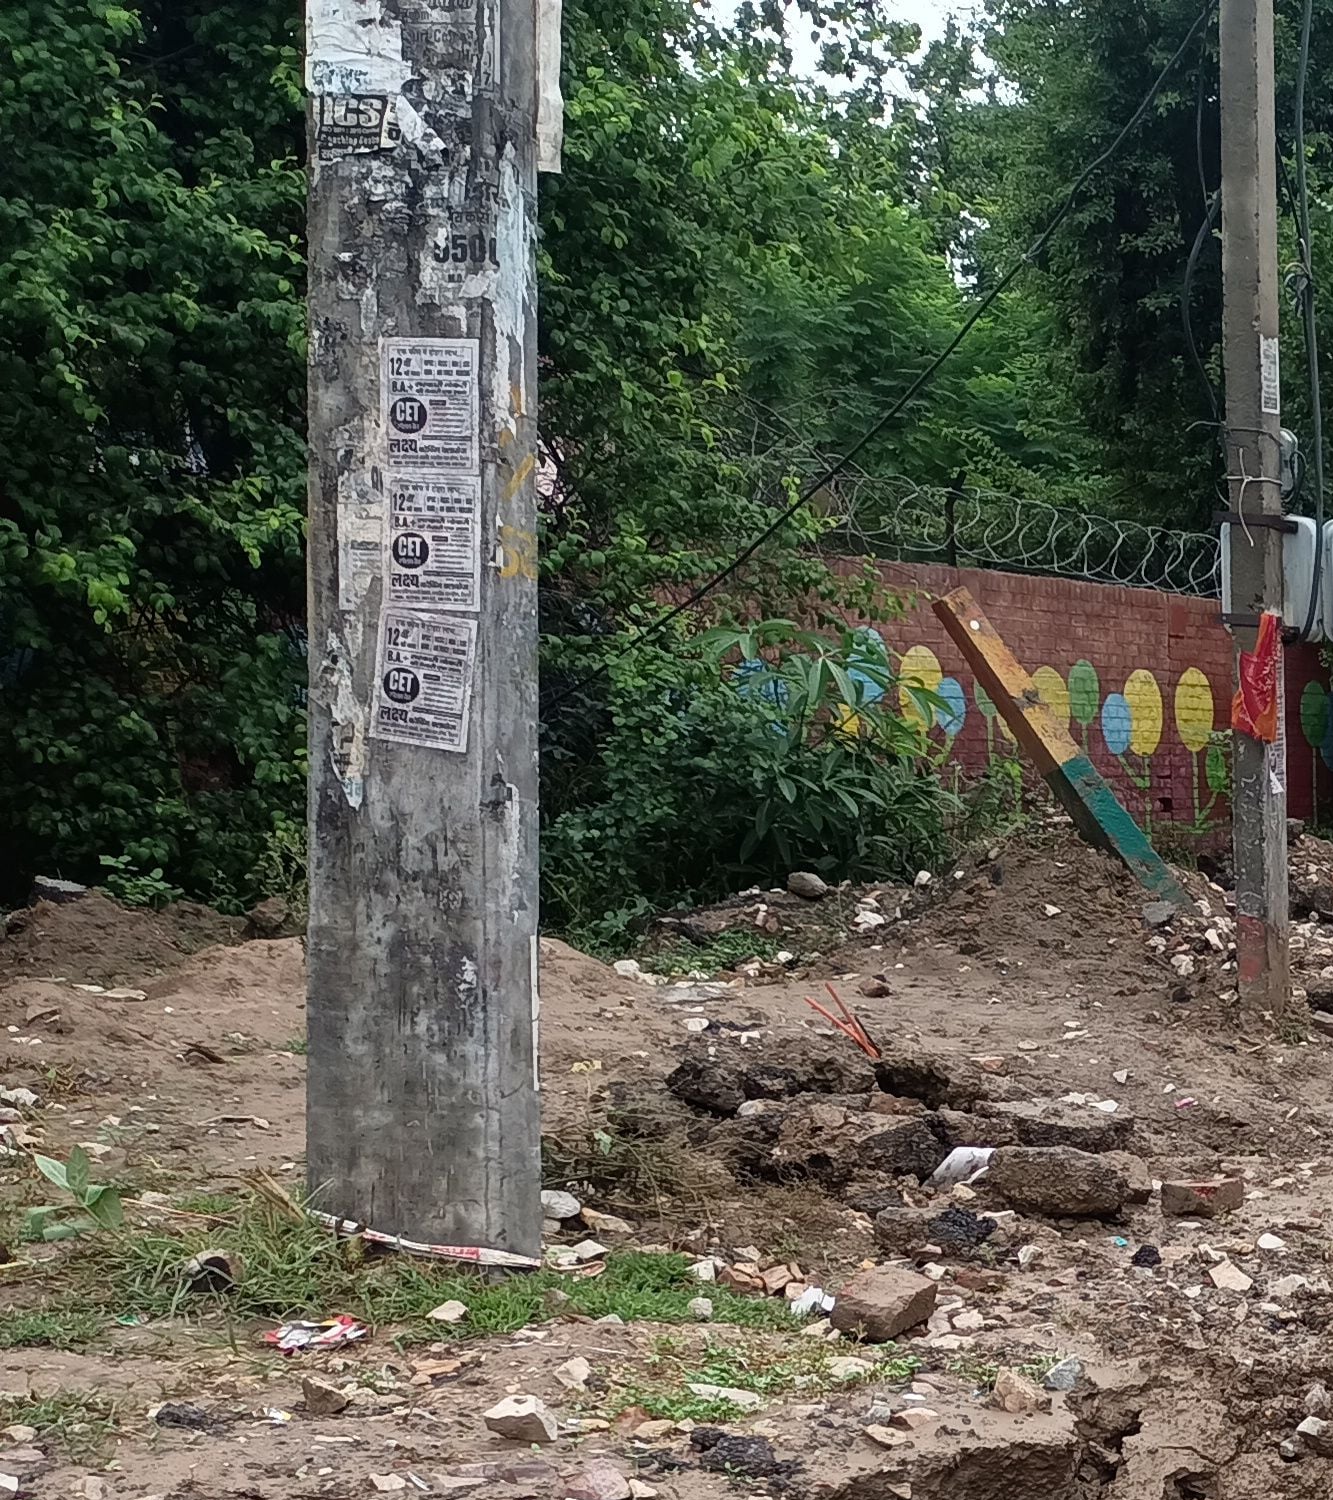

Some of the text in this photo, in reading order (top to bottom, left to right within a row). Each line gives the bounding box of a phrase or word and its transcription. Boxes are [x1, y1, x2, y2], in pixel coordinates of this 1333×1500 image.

[323, 97, 381, 126] ICS
[390, 357, 402, 375] 12
[396, 401, 420, 421] CET
[389, 439, 417, 452] लक्ष्य
[392, 493, 405, 510] 12
[398, 536, 422, 556] CET
[390, 573, 419, 587] लक्ष्य
[387, 627, 399, 645] 12
[389, 671, 413, 691] CET
[379, 707, 407, 721] लक्ष्य
